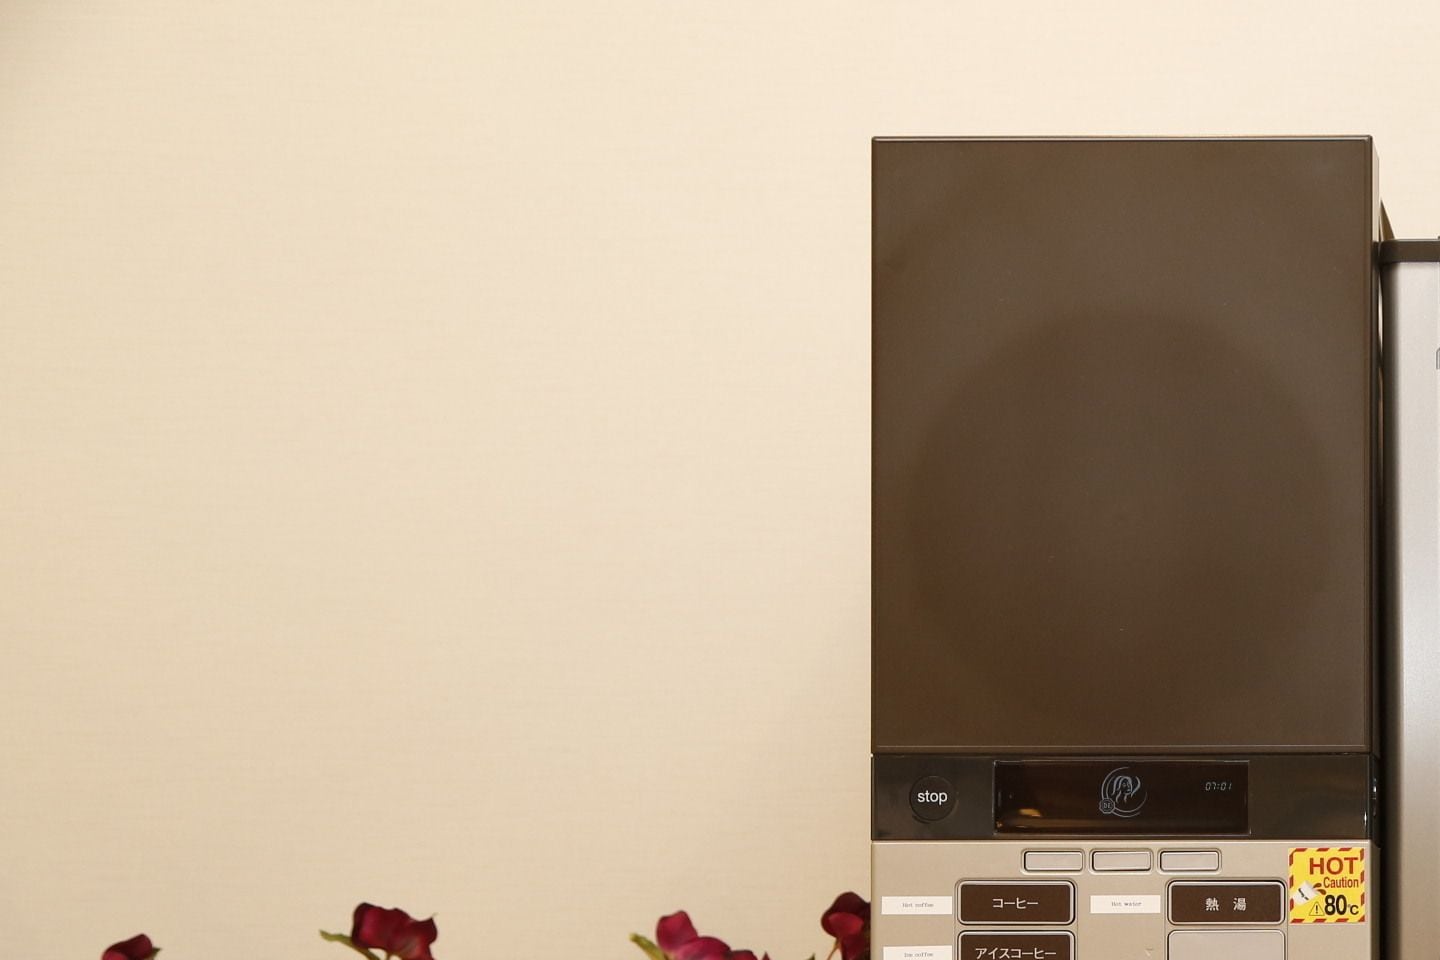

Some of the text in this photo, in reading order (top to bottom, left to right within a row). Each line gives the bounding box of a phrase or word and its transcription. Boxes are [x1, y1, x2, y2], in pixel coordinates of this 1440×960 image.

[1205, 781, 1233, 791] 07:01
[917, 790, 948, 805] stop
[1309, 857, 1359, 875] HOT
[1323, 876, 1359, 888] Caution
[992, 897, 1039, 909] コーヒー
[975, 947, 1056, 960] アイスコーヒー
